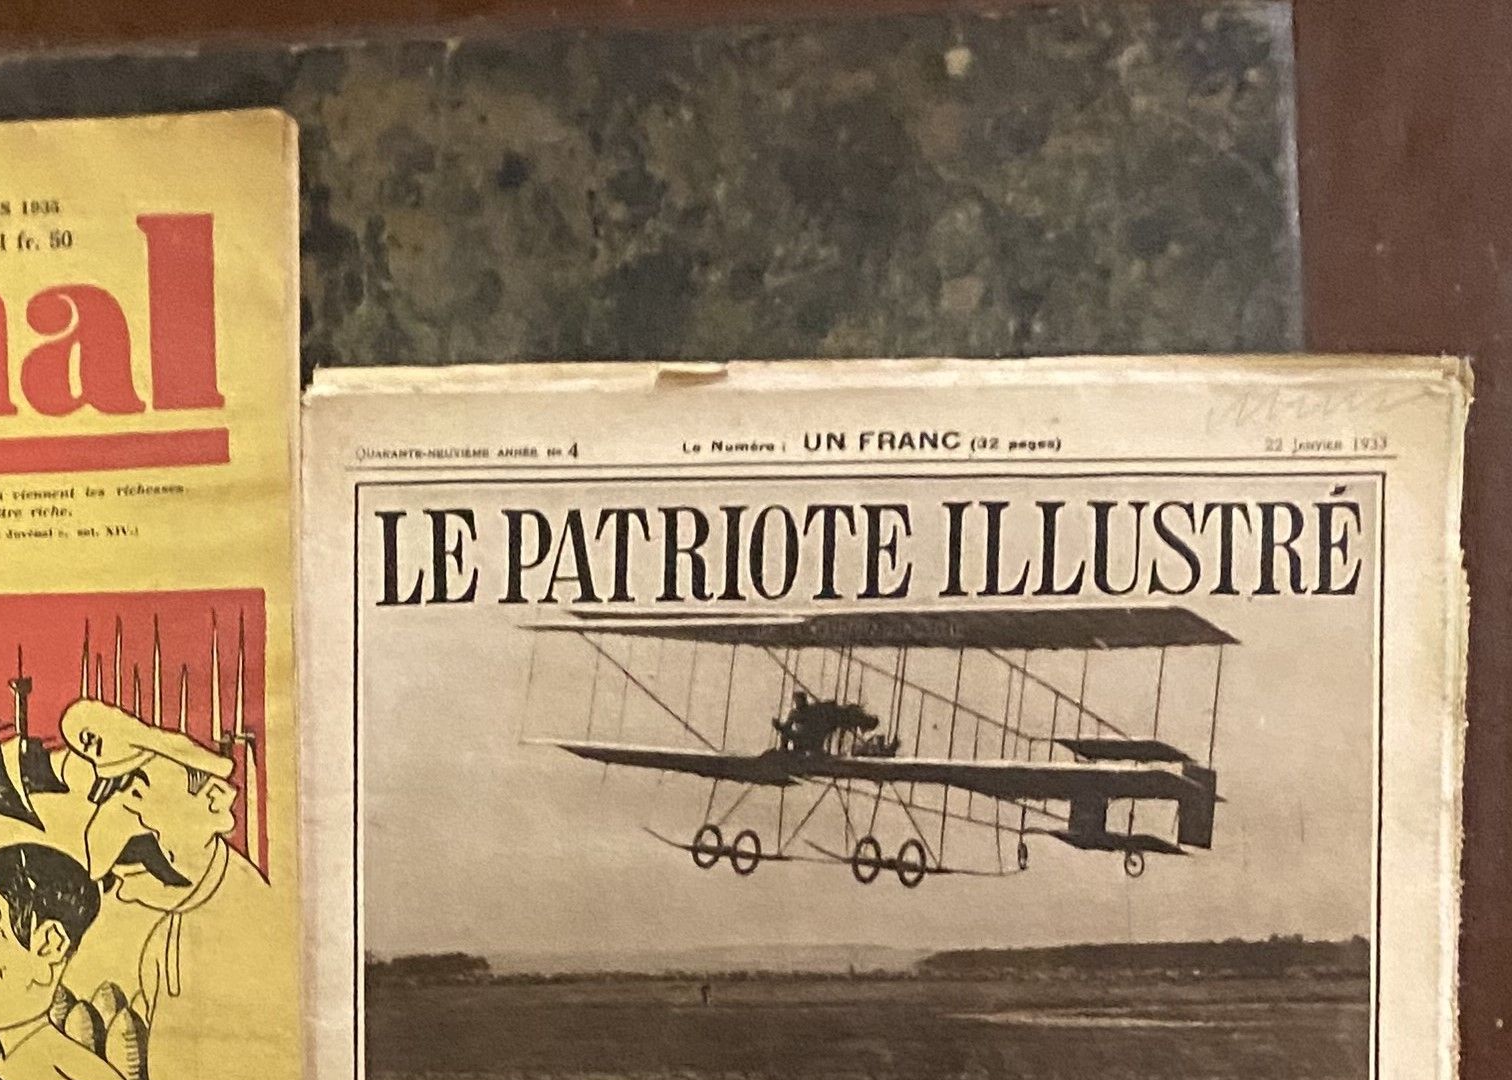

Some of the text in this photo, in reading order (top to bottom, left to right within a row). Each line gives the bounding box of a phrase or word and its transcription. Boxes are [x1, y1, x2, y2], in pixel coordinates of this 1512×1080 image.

[17, 230, 39, 250] fr.
[49, 228, 73, 249] 50
[568, 442, 578, 459] 4
[682, 440, 701, 454] Le
[711, 439, 776, 453] Numéro
[803, 431, 847, 452] UN
[860, 430, 961, 451] FRANC
[12, 487, 75, 500] viennent
[374, 485, 1363, 606] LE PATRIOTE ILLUSTRÉ
